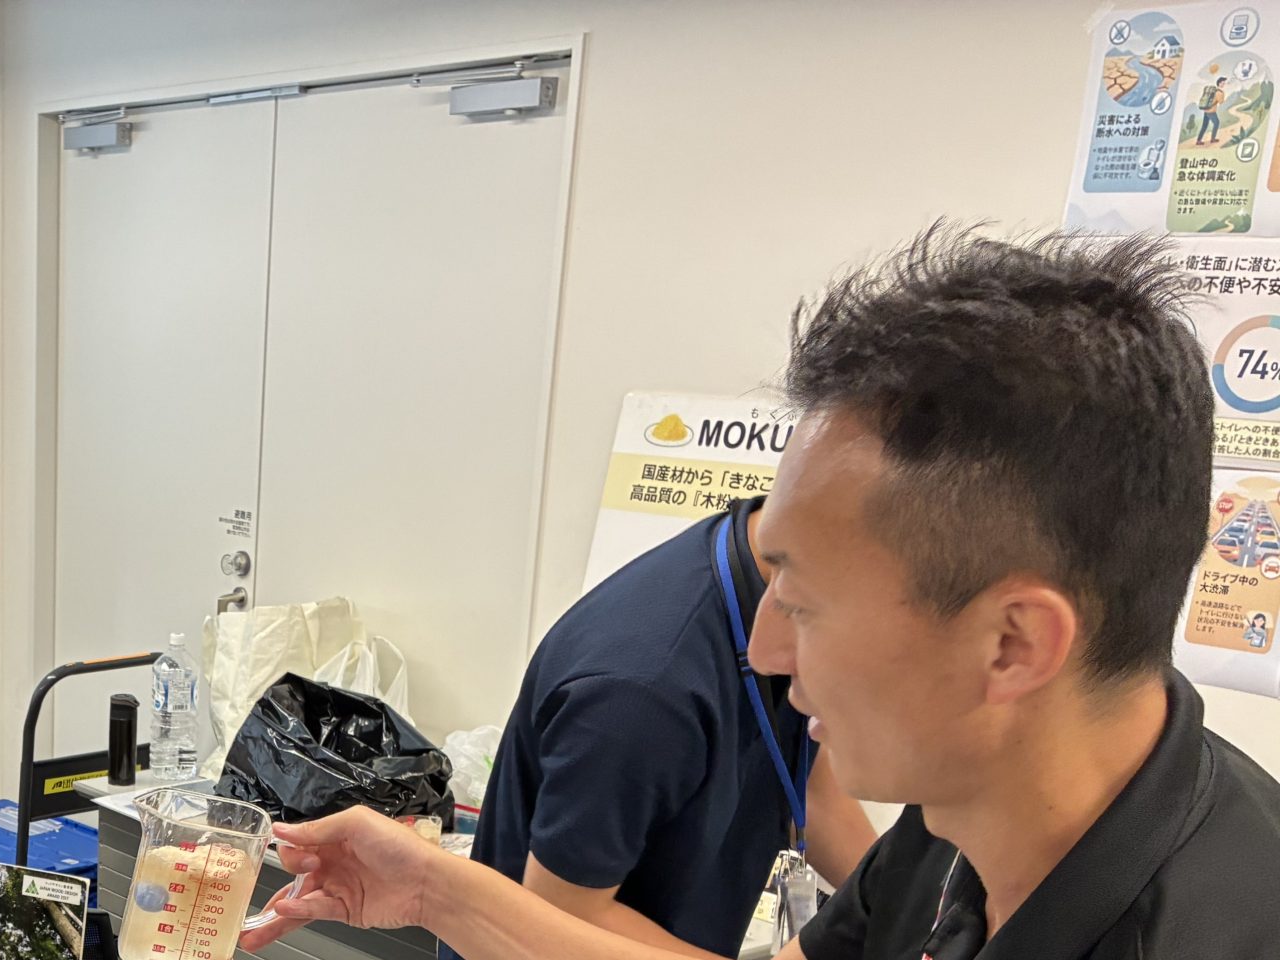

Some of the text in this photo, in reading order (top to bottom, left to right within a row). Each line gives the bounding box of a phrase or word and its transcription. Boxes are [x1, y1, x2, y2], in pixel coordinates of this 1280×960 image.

[1098, 114, 1141, 125] 災害による
[1095, 126, 1149, 139] 断水への対策
[1179, 158, 1218, 169] 登山中の
[1176, 170, 1236, 182] 急な体調変化
[641, 464, 775, 492] 国産材から「きなこ
[1218, 501, 1233, 509] STOP
[1203, 570, 1259, 586] ドライブ中の
[1199, 582, 1230, 595] 大渋滞
[216, 860, 238, 870] 500
[209, 881, 231, 892] 400
[206, 893, 223, 902] 350
[203, 904, 224, 915] 300
[200, 916, 217, 925] 250
[196, 927, 218, 937] 200
[195, 938, 210, 947] 150
[192, 950, 211, 960] 100
